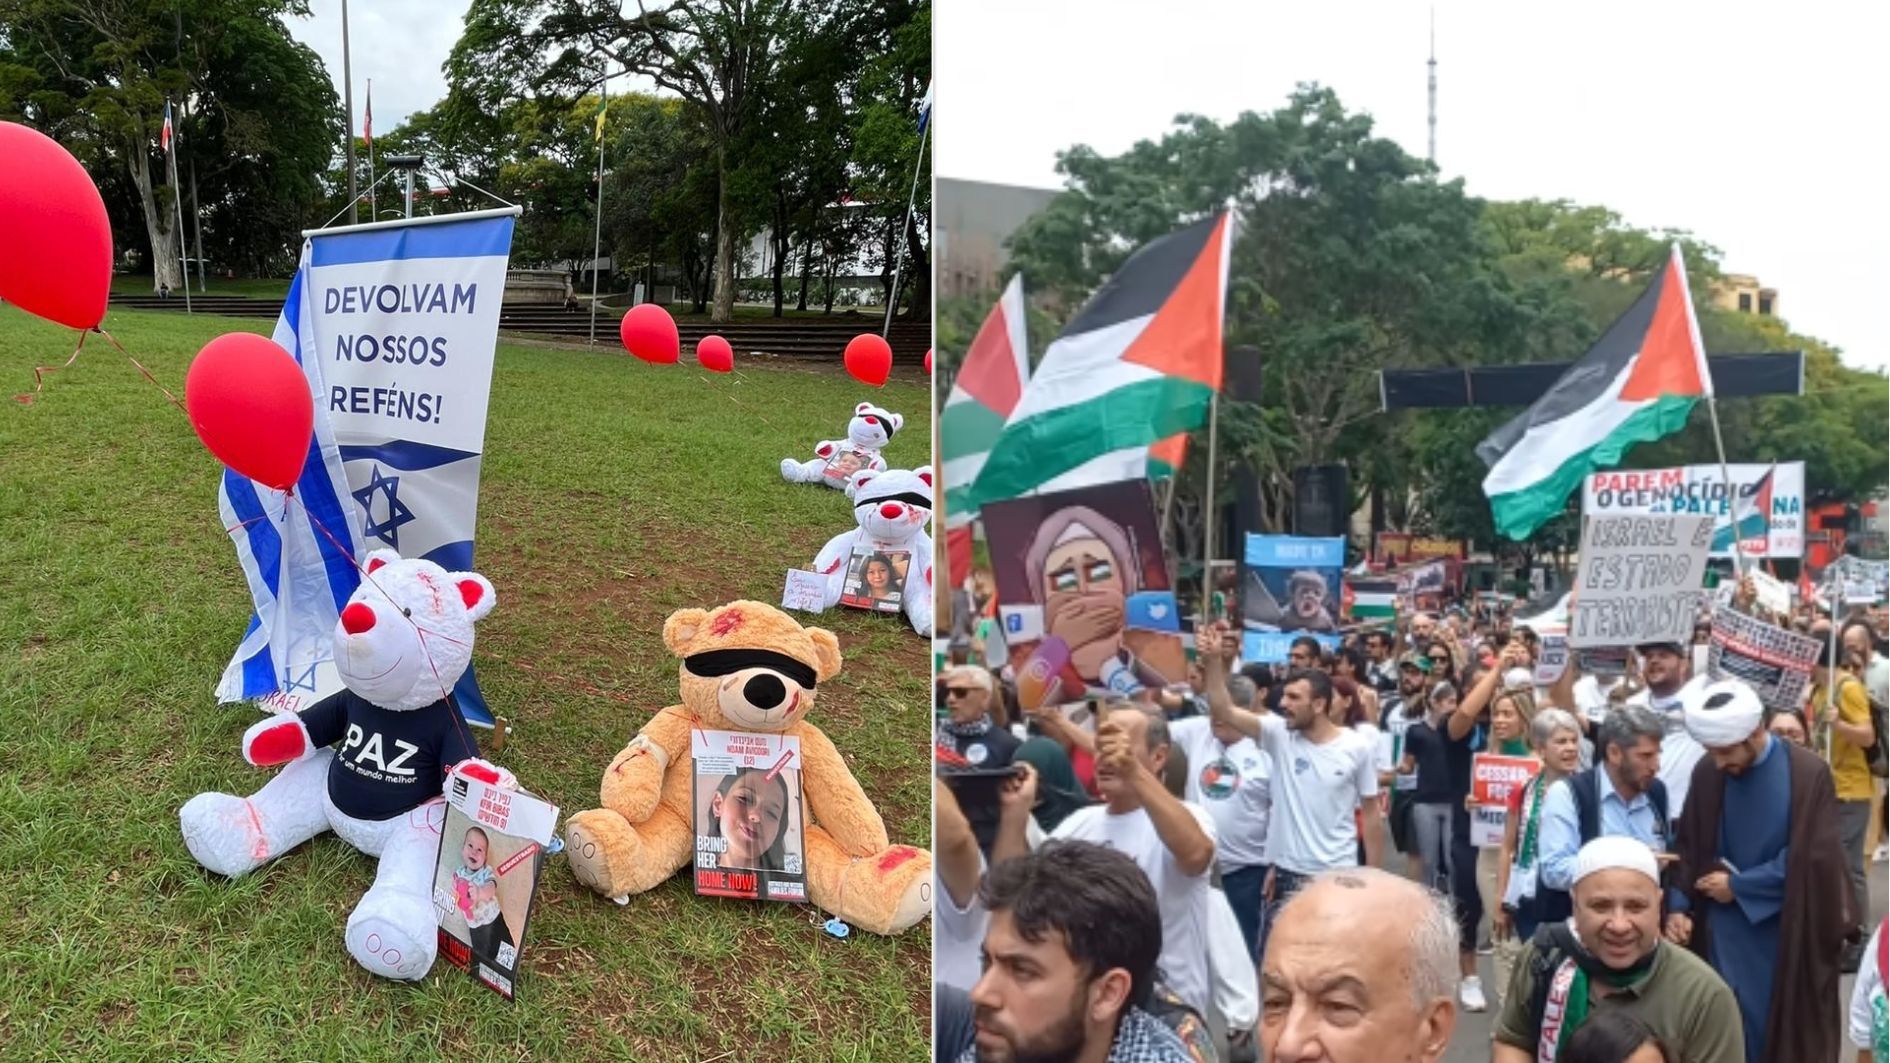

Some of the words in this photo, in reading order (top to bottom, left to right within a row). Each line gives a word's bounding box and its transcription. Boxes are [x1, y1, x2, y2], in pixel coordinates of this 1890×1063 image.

[324, 282, 478, 315] DEVOLVAM
[336, 334, 447, 367] NOSSOS
[330, 382, 443, 424] REFÉNS!
[1592, 468, 1683, 492] PAREM
[1671, 496, 1800, 516] PALENA
[1591, 517, 1678, 547] ISRAEL
[1586, 553, 1692, 591] ESTADO
[342, 723, 419, 775] PAZ
[345, 761, 355, 771] um
[356, 766, 383, 780] mundo
[385, 774, 418, 783] melhor
[697, 835, 727, 853] BRING
[697, 852, 717, 869] HER
[698, 870, 725, 888] HOME
[728, 872, 757, 890] NOW!
[433, 885, 455, 914] BRING
